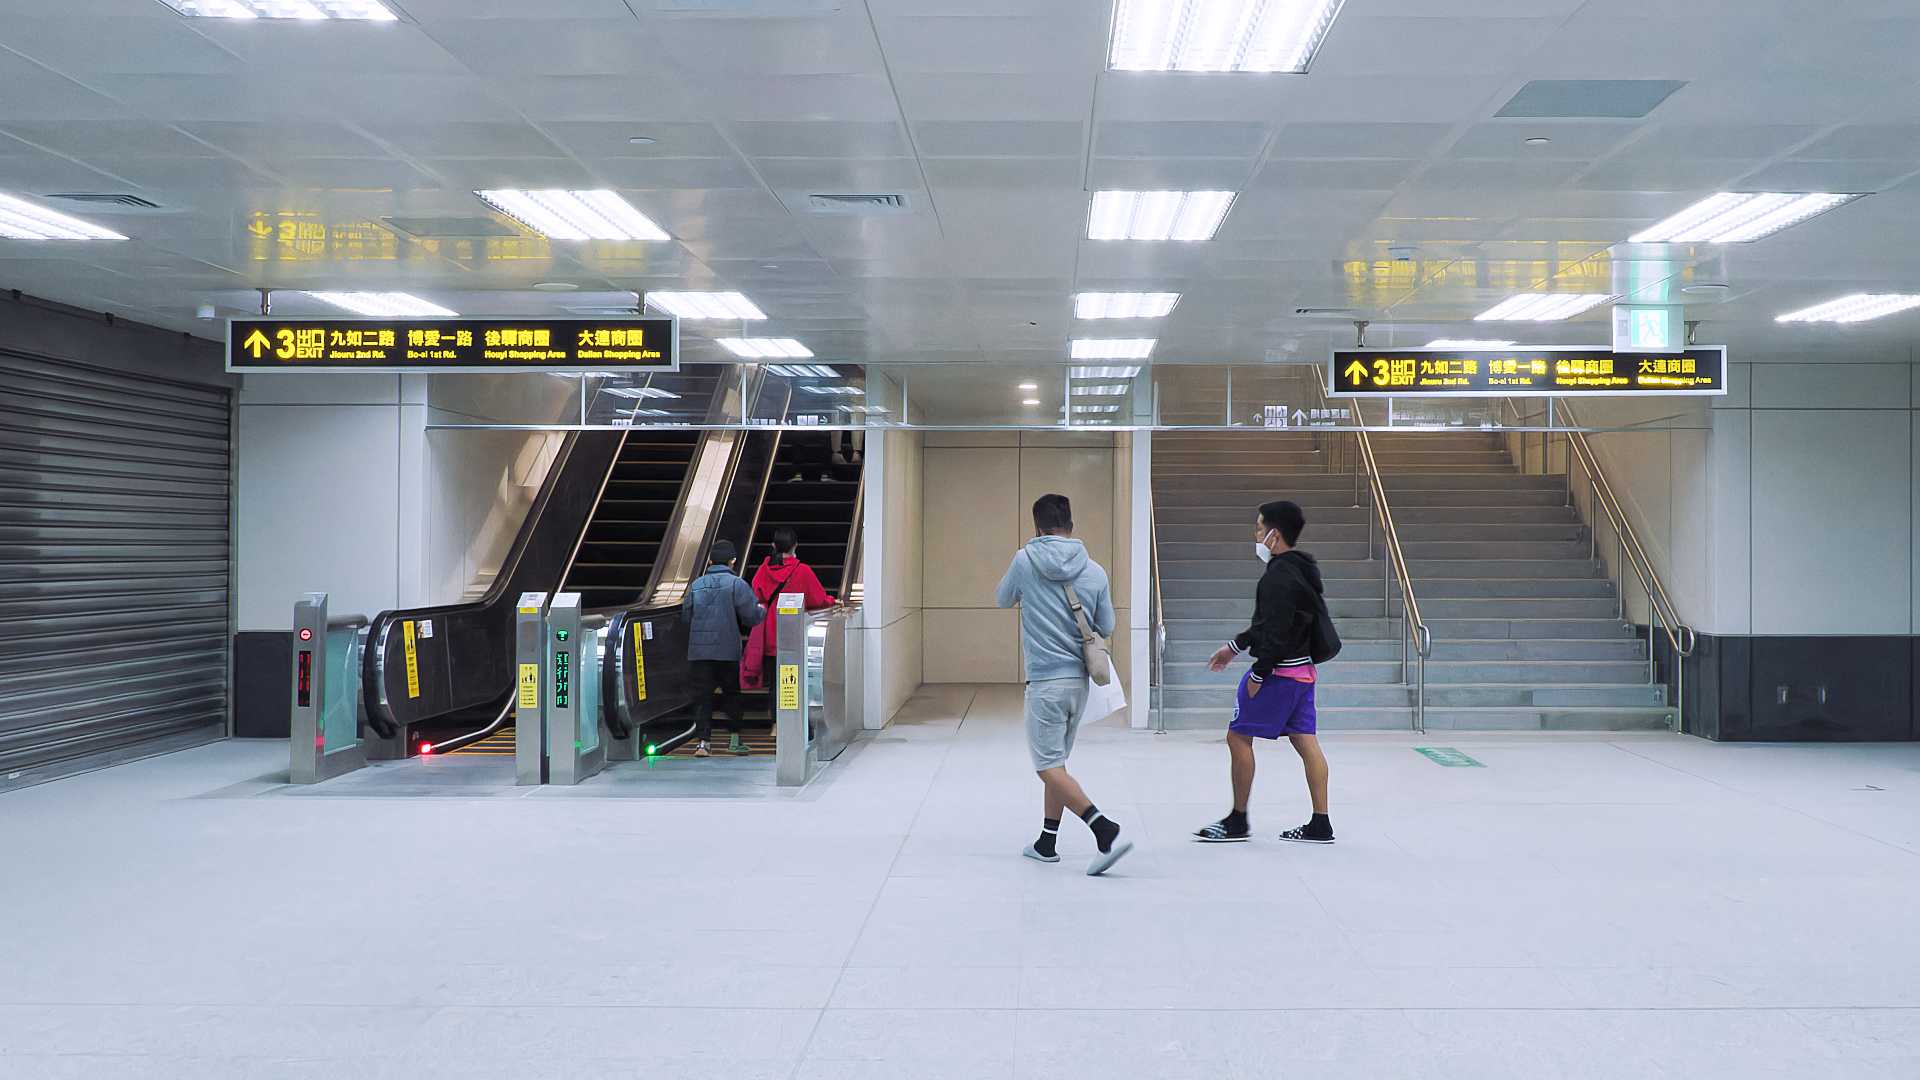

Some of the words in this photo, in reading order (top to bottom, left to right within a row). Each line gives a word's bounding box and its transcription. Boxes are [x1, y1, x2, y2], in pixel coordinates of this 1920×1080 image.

[276, 329, 296, 359] 3
[297, 329, 325, 349] 出口
[330, 330, 395, 347] 九如二路
[407, 330, 473, 347] 博愛一路
[484, 329, 550, 347] 後驛商圈
[578, 329, 643, 347] 大連商圈
[297, 348, 324, 359] EXIT
[355, 350, 372, 359] 2nd
[372, 350, 387, 359] Rd.
[429, 350, 443, 359] 1st
[443, 350, 457, 359] Rd.
[508, 350, 547, 360] Shopping
[547, 350, 566, 359] Area
[603, 350, 642, 360] Shopping
[642, 350, 661, 359] Area
[1372, 359, 1390, 386] 3
[1391, 359, 1416, 374] 出口
[1420, 359, 1477, 375] 九如二路
[1391, 374, 1415, 386] EXIT
